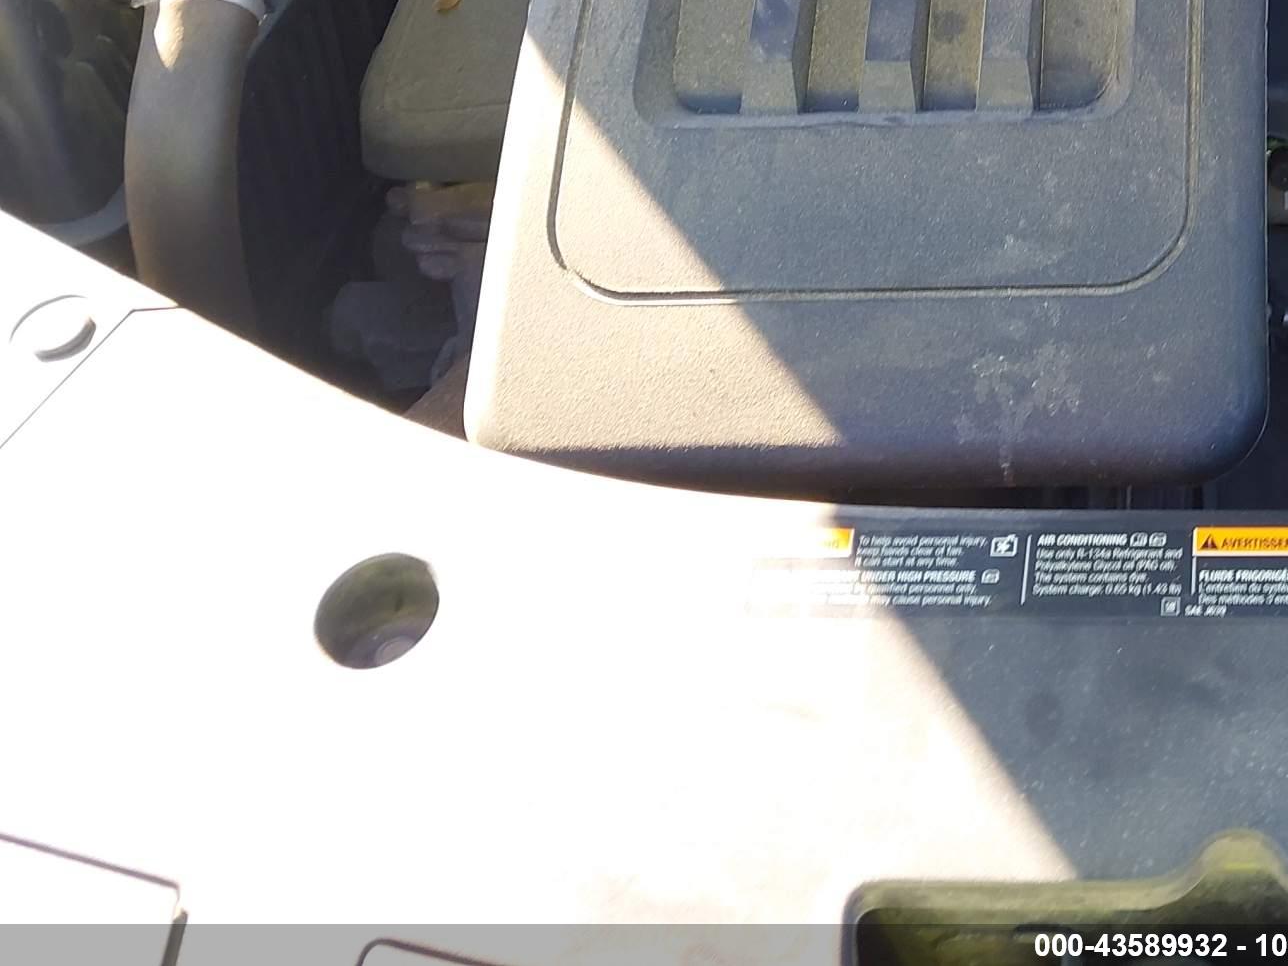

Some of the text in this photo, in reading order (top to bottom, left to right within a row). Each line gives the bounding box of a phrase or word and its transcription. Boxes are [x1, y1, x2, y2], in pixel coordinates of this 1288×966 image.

[860, 536, 870, 547] To
[871, 536, 892, 547] help
[893, 536, 917, 547] avoid
[919, 536, 959, 547] personal
[1037, 534, 1127, 546] AIR CONDITIONING
[911, 546, 934, 556] clear
[935, 546, 945, 556] of
[1036, 548, 1054, 559] Use
[1055, 548, 1075, 559] only
[1077, 548, 1111, 559] R-134a
[1165, 548, 1183, 559] and
[863, 557, 880, 568] can
[882, 557, 904, 568] start
[905, 557, 914, 568] at
[916, 557, 935, 568] any
[861, 570, 895, 582] UNDER
[897, 570, 922, 582] HIGH
[923, 570, 976, 582] PRESSURE
[1035, 572, 1051, 583] The
[1053, 572, 1087, 583] system
[1088, 572, 1128, 583] contains
[1200, 569, 1234, 582] FLUIDE
[909, 584, 954, 594] personnel
[1033, 584, 1068, 596] System
[1128, 584, 1141, 596] kg
[892, 595, 920, 606] cause
[922, 595, 963, 606] personal
